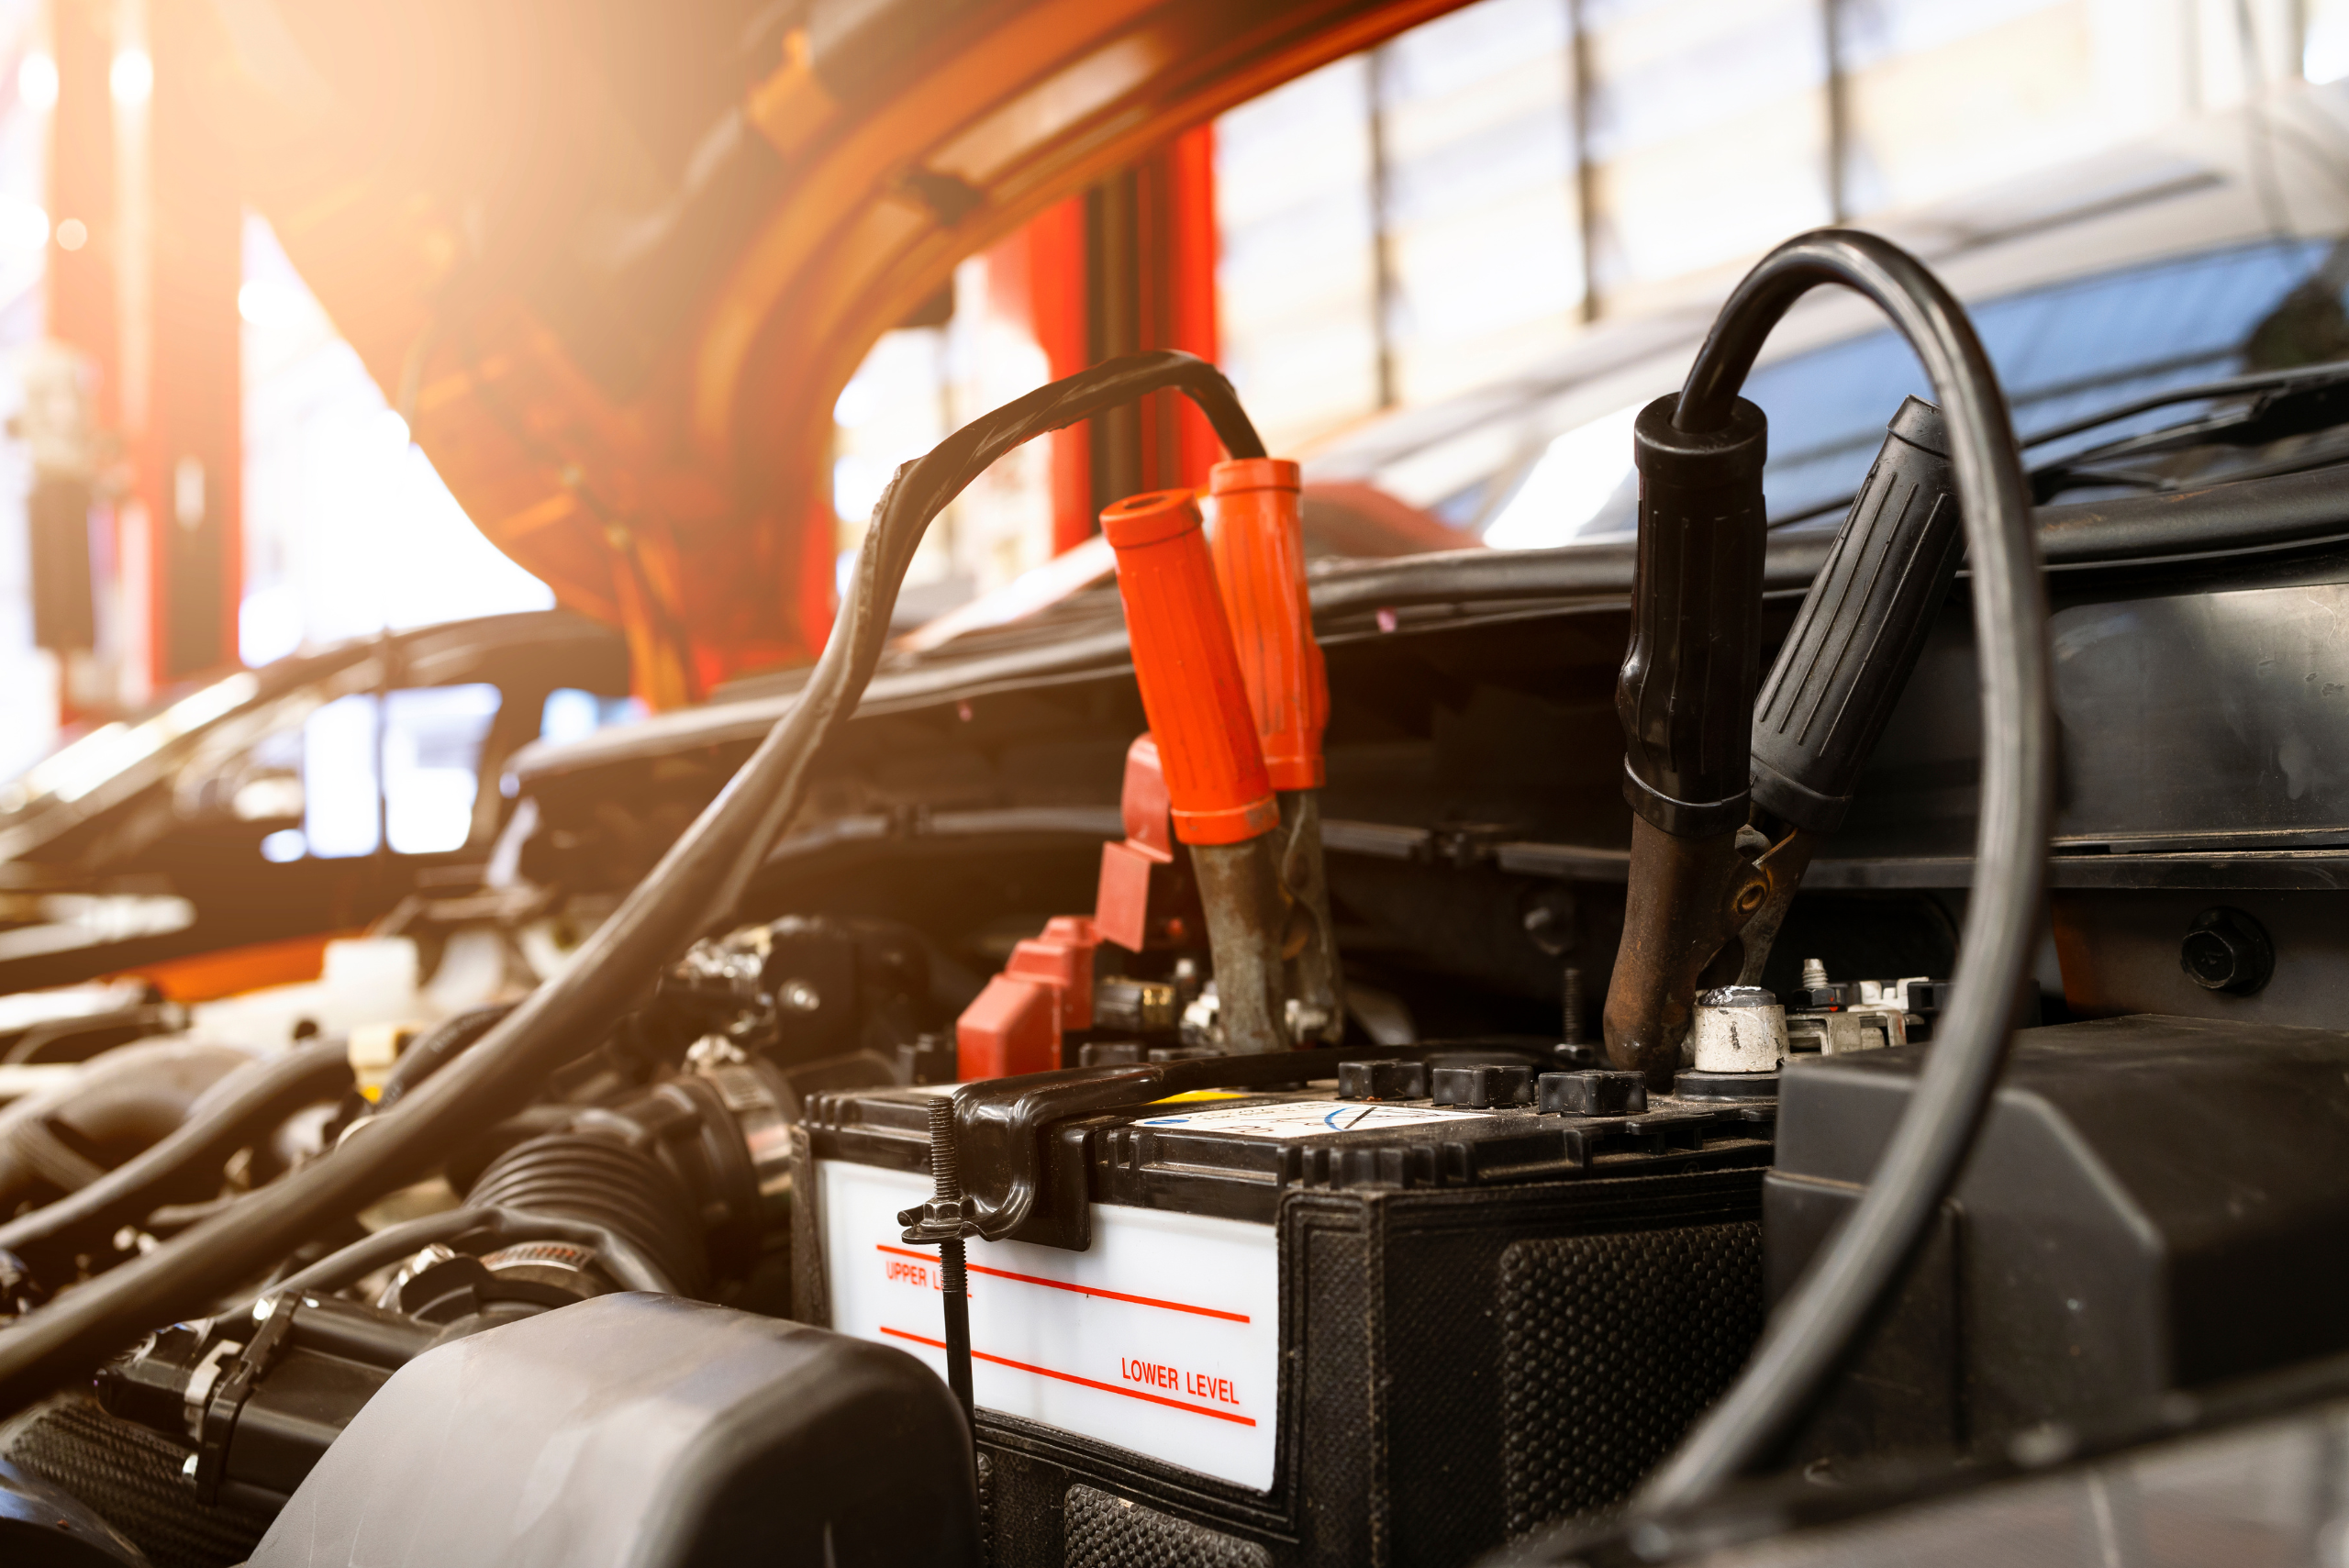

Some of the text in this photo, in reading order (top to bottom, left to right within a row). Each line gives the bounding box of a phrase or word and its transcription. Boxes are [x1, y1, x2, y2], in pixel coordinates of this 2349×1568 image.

[886, 1261, 928, 1287] UPPER
[1121, 1357, 1241, 1406] LOWER LEVEL
